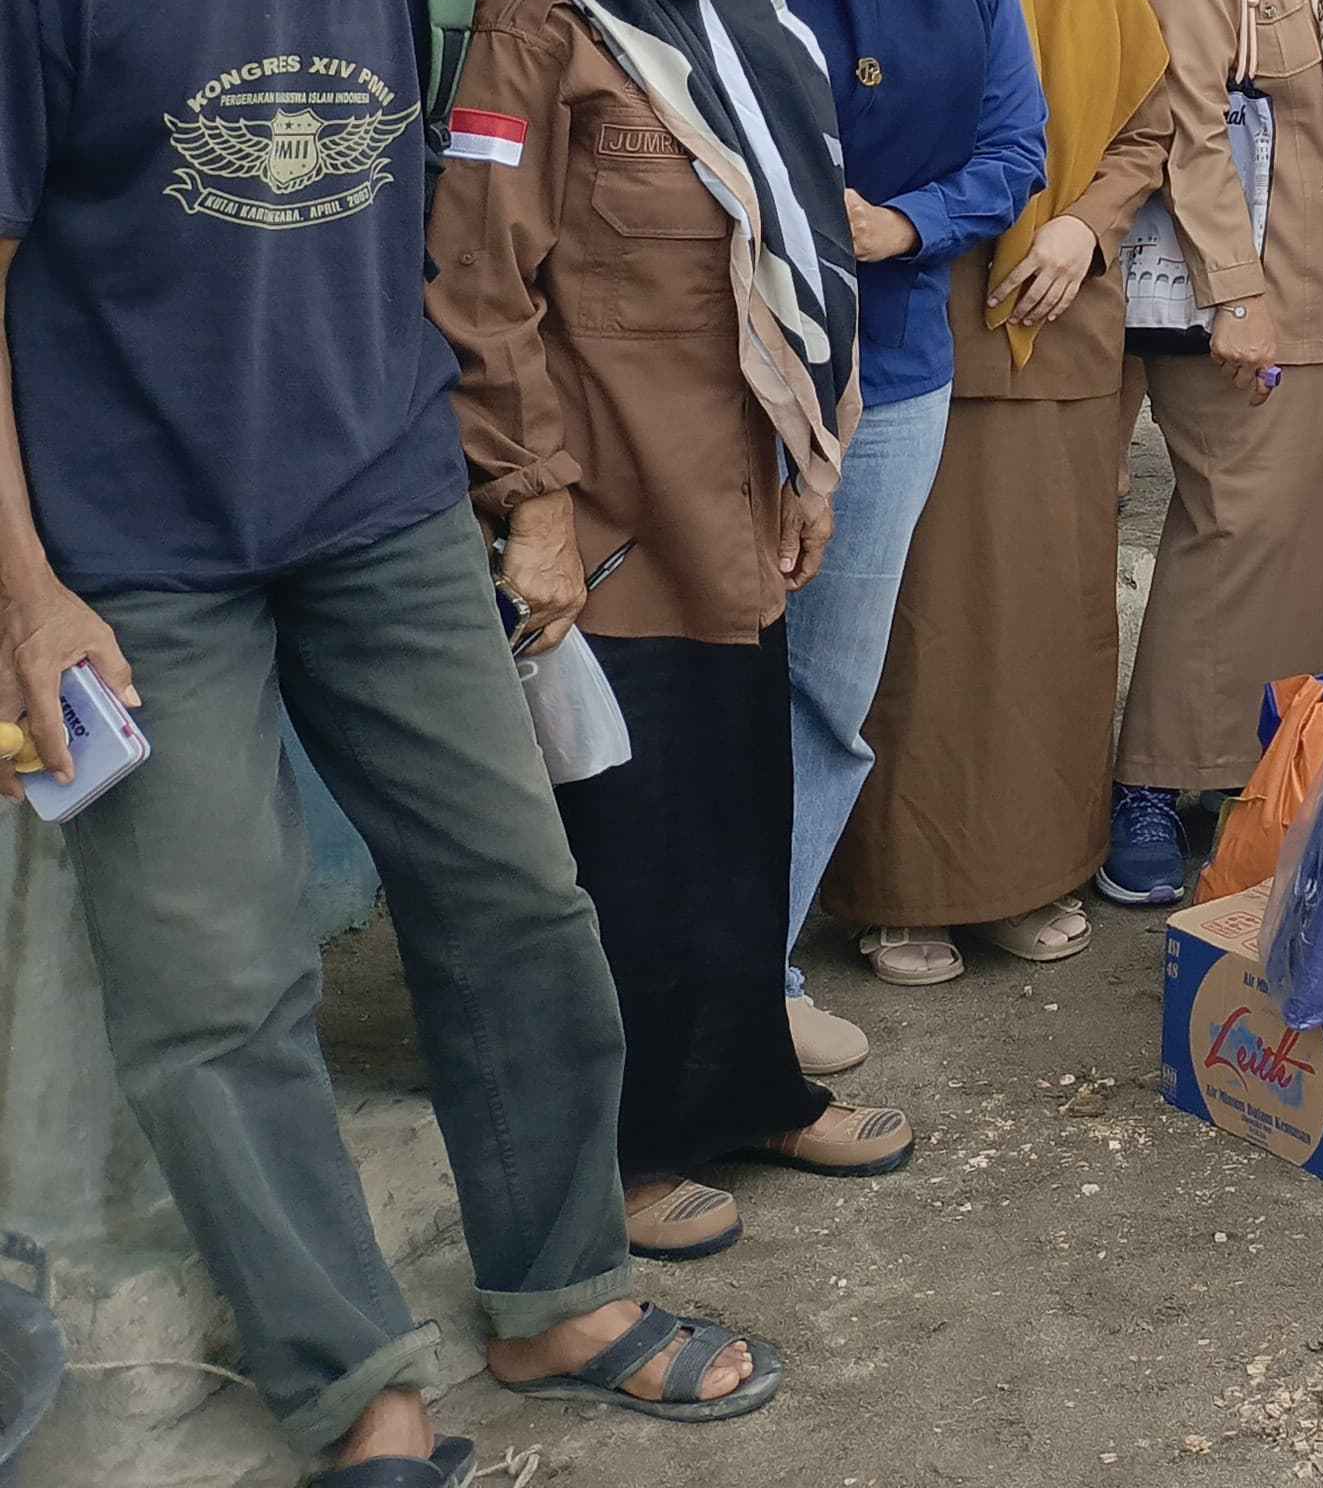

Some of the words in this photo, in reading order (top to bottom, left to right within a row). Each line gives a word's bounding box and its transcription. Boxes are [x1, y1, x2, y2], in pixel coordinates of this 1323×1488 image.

[187, 55, 301, 113] KONGRES
[308, 56, 357, 80] XIV
[357, 67, 395, 107] PMII
[220, 93, 274, 106] PERGERAKAN
[308, 92, 333, 104] ISLAM
[205, 194, 238, 214] KUTAI
[310, 202, 343, 218] APRIL
